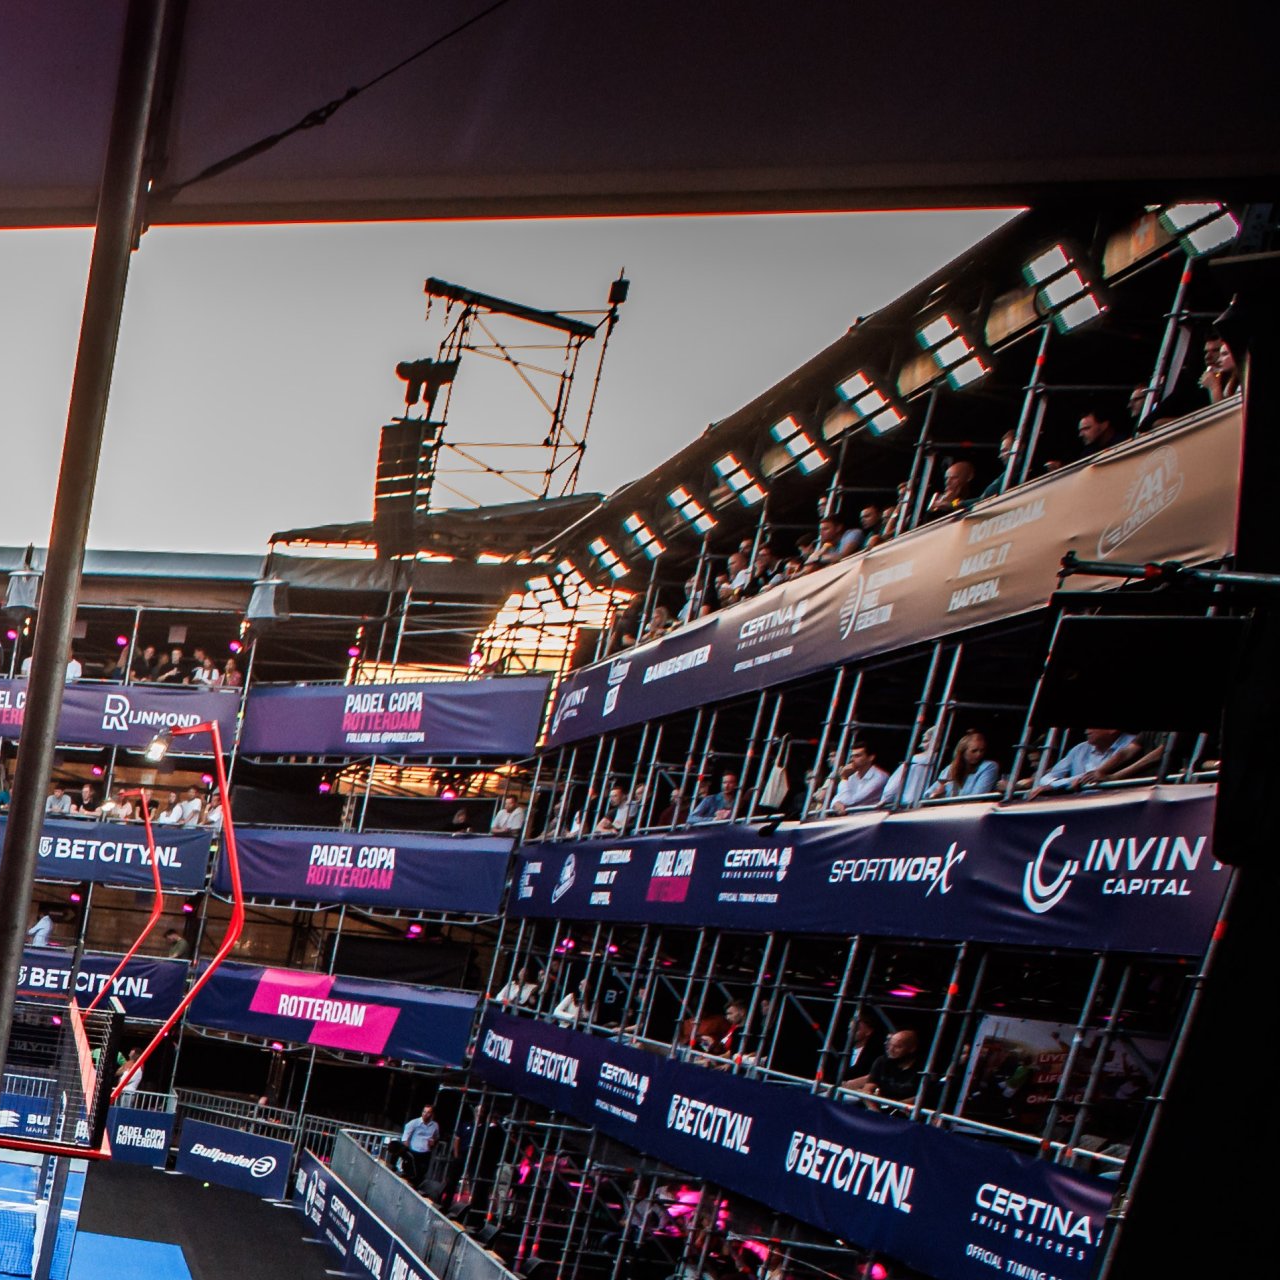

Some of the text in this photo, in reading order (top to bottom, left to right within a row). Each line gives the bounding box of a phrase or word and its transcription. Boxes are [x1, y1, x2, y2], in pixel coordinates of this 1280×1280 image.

[958, 550, 996, 578] MAKE
[947, 577, 1000, 613] HAPPEN.
[739, 605, 797, 639] CERTINA
[344, 691, 423, 713] PADEL COPA
[343, 711, 422, 731] ROTTERDAM
[55, 838, 182, 868] BETCITY.NL
[309, 844, 395, 869] PADEL COPA
[724, 849, 778, 867] CERTINA
[1083, 836, 1223, 872] INVIN
[305, 866, 394, 890] ROTTERDAM
[829, 841, 966, 898] SPORTWORX
[1101, 878, 1191, 896] CAPITAL
[29, 967, 153, 998] BETCITY.NL
[278, 994, 367, 1027] ROTTERDAM
[532, 1047, 580, 1087] BETCITY.NL
[600, 1062, 640, 1088] CERTINA
[117, 1125, 166, 1140] PADEL COPA
[675, 1096, 753, 1154] BETCITY.NL
[116, 1134, 165, 1150] ROTTERDAM
[190, 1142, 254, 1169] Bullpadel
[796, 1134, 915, 1214] BETCITY.NL
[975, 1182, 1093, 1244] CERTINA
[970, 1211, 1086, 1261] SWISS WATCHES
[965, 1243, 1002, 1270] OFFICIAL
